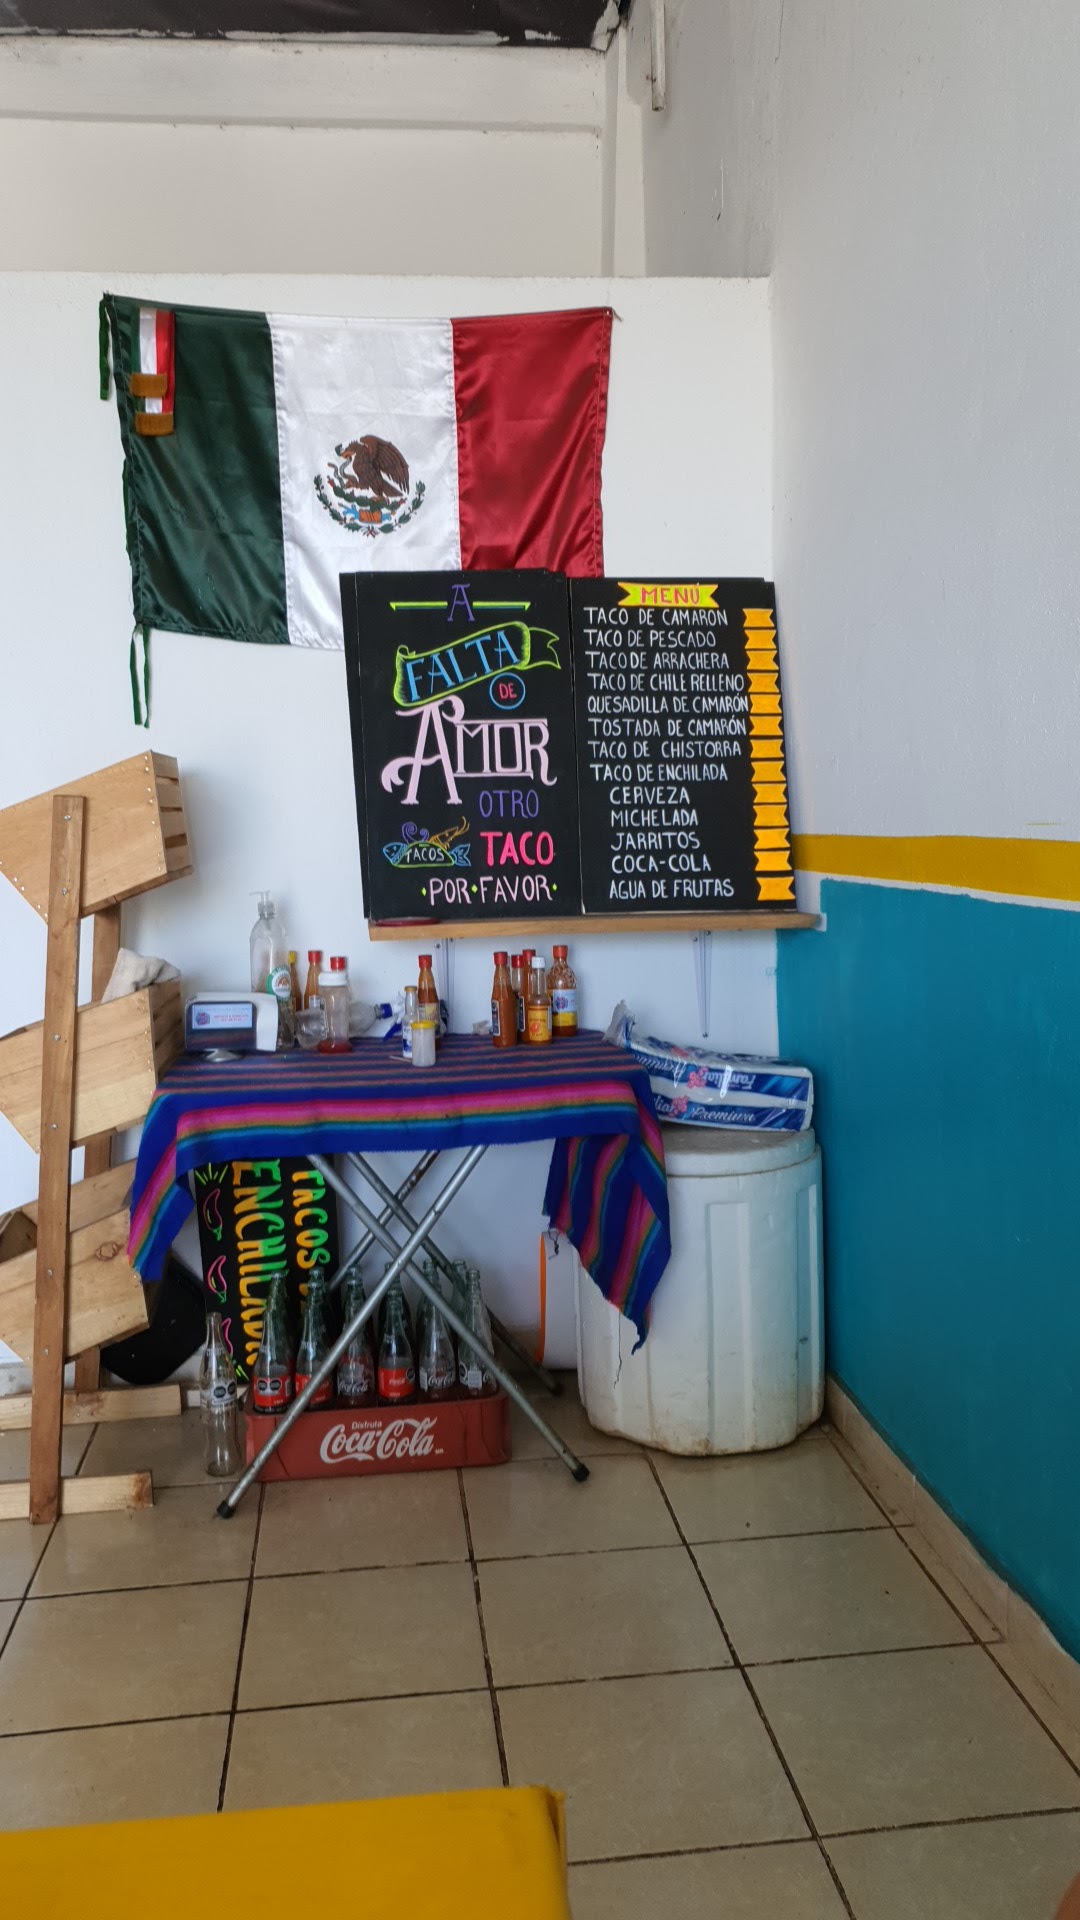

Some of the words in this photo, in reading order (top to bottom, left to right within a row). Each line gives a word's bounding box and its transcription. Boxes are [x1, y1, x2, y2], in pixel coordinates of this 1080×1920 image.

[447, 583, 475, 621] A
[584, 605, 630, 625] TACO
[637, 605, 656, 625] DE
[662, 607, 727, 626] CAMARON
[584, 629, 622, 647] TACO
[628, 630, 644, 647] DE
[650, 630, 715, 648] PESCADO
[405, 630, 521, 702] FALTA
[585, 651, 627, 669] TACO
[630, 652, 647, 669] DE
[654, 652, 729, 669] ARRACHERA
[499, 683, 516, 699] DE
[587, 673, 625, 690] TACO
[631, 674, 644, 691] DE
[650, 674, 686, 691] CHILE
[691, 674, 744, 691] RELLENO
[588, 696, 668, 713] QUESADILLA
[673, 696, 689, 712] DE
[693, 691, 749, 713] CAMARÓN
[588, 718, 660, 736] TOSTADA
[668, 719, 683, 736] DE
[688, 715, 746, 736] CAMARÓN
[381, 693, 557, 804] AMOR
[588, 741, 626, 759] TACO
[634, 741, 649, 758] DE
[662, 741, 741, 758] CHISTORRA
[590, 764, 631, 781] TACO
[637, 764, 654, 782] DE
[658, 764, 727, 781] ENCHILADA
[480, 790, 538, 817] OTRO
[610, 786, 689, 805] CERVEZA
[611, 809, 698, 827] MICHELADA
[480, 832, 553, 866] TACO
[611, 832, 700, 851] JARRITOS
[404, 848, 446, 864] TACOS
[612, 854, 711, 874] COCA-COLA
[430, 878, 471, 905] POR
[480, 875, 552, 902] FAVOR
[610, 880, 646, 899] AGUA
[652, 880, 668, 898] DE
[674, 879, 734, 898] FRUTAS
[703, 1071, 756, 1090] Famliar
[691, 1106, 756, 1122] Premium
[292, 1170, 331, 1270] TACOS
[351, 1420, 383, 1430] Disfruta
[320, 1416, 438, 1464] Coca-Cola
